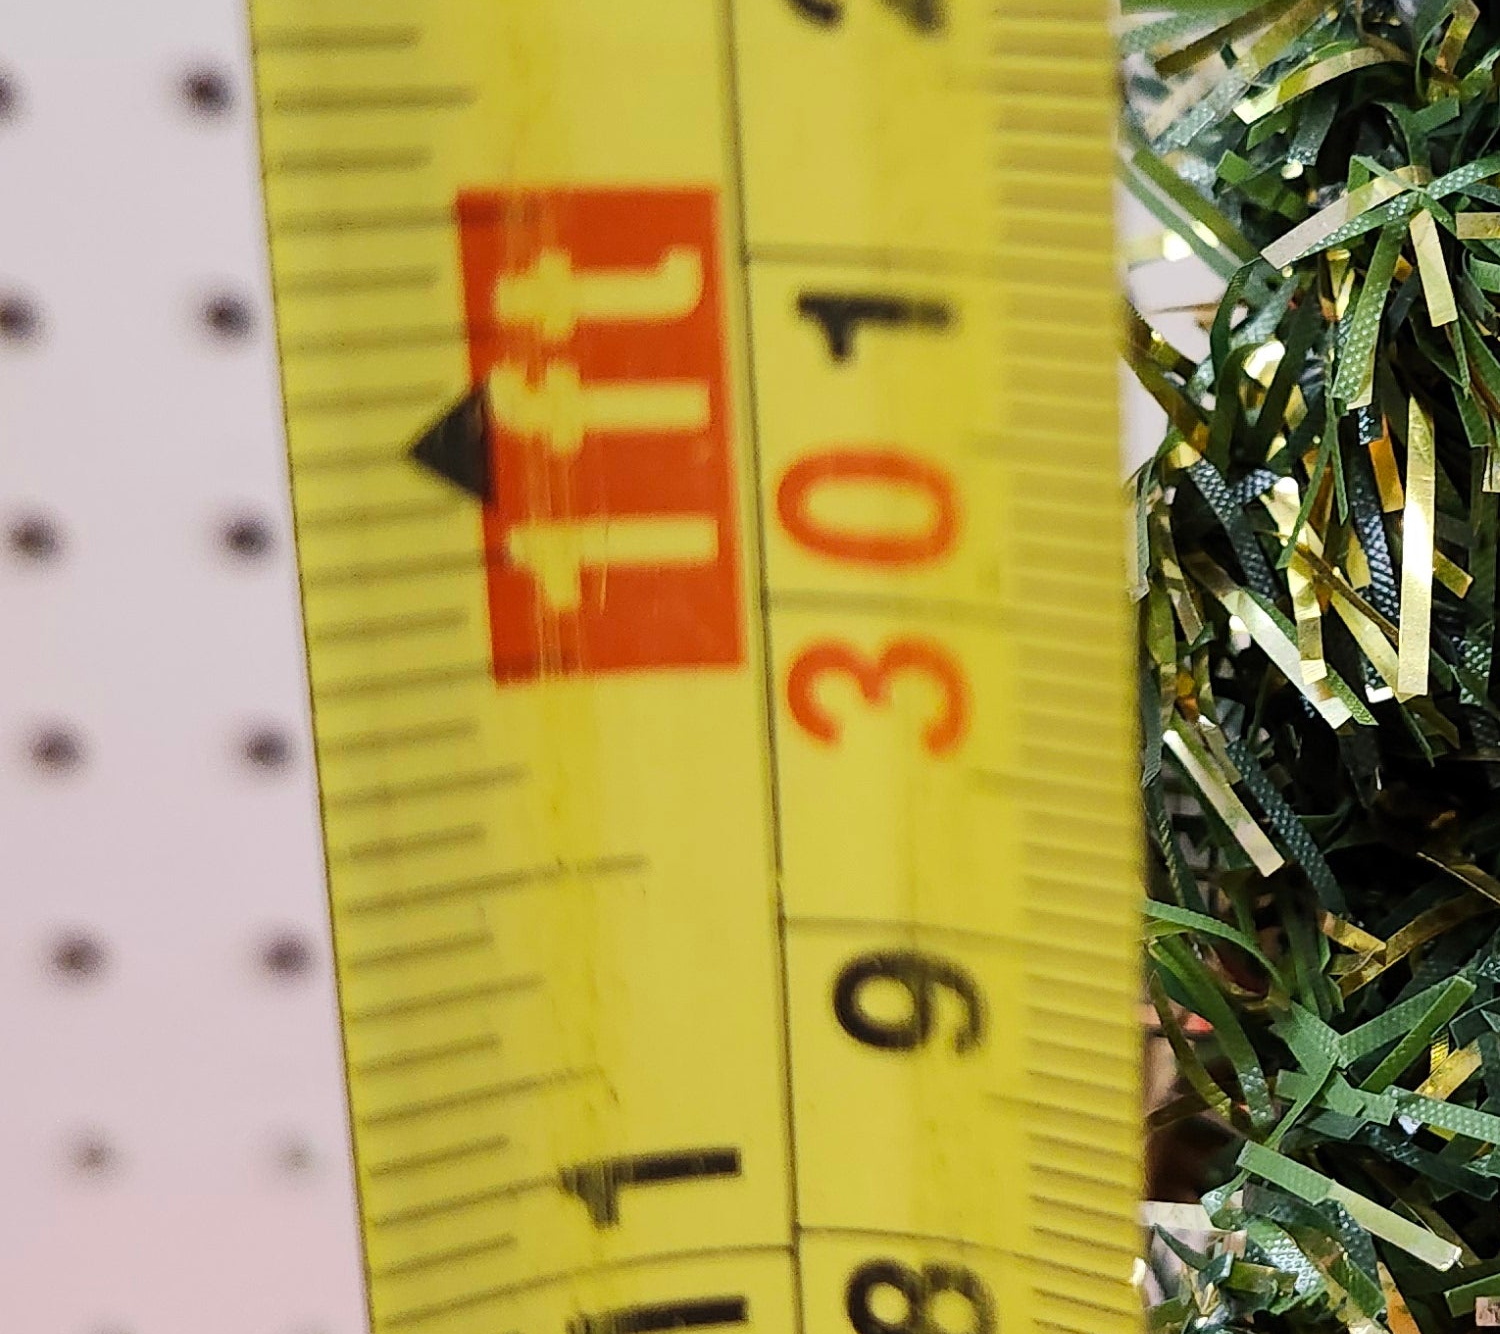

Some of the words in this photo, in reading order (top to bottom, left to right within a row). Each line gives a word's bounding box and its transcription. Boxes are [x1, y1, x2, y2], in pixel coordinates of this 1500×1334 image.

[796, 289, 954, 365] 1
[775, 447, 972, 757] 30
[833, 948, 988, 1057] 9
